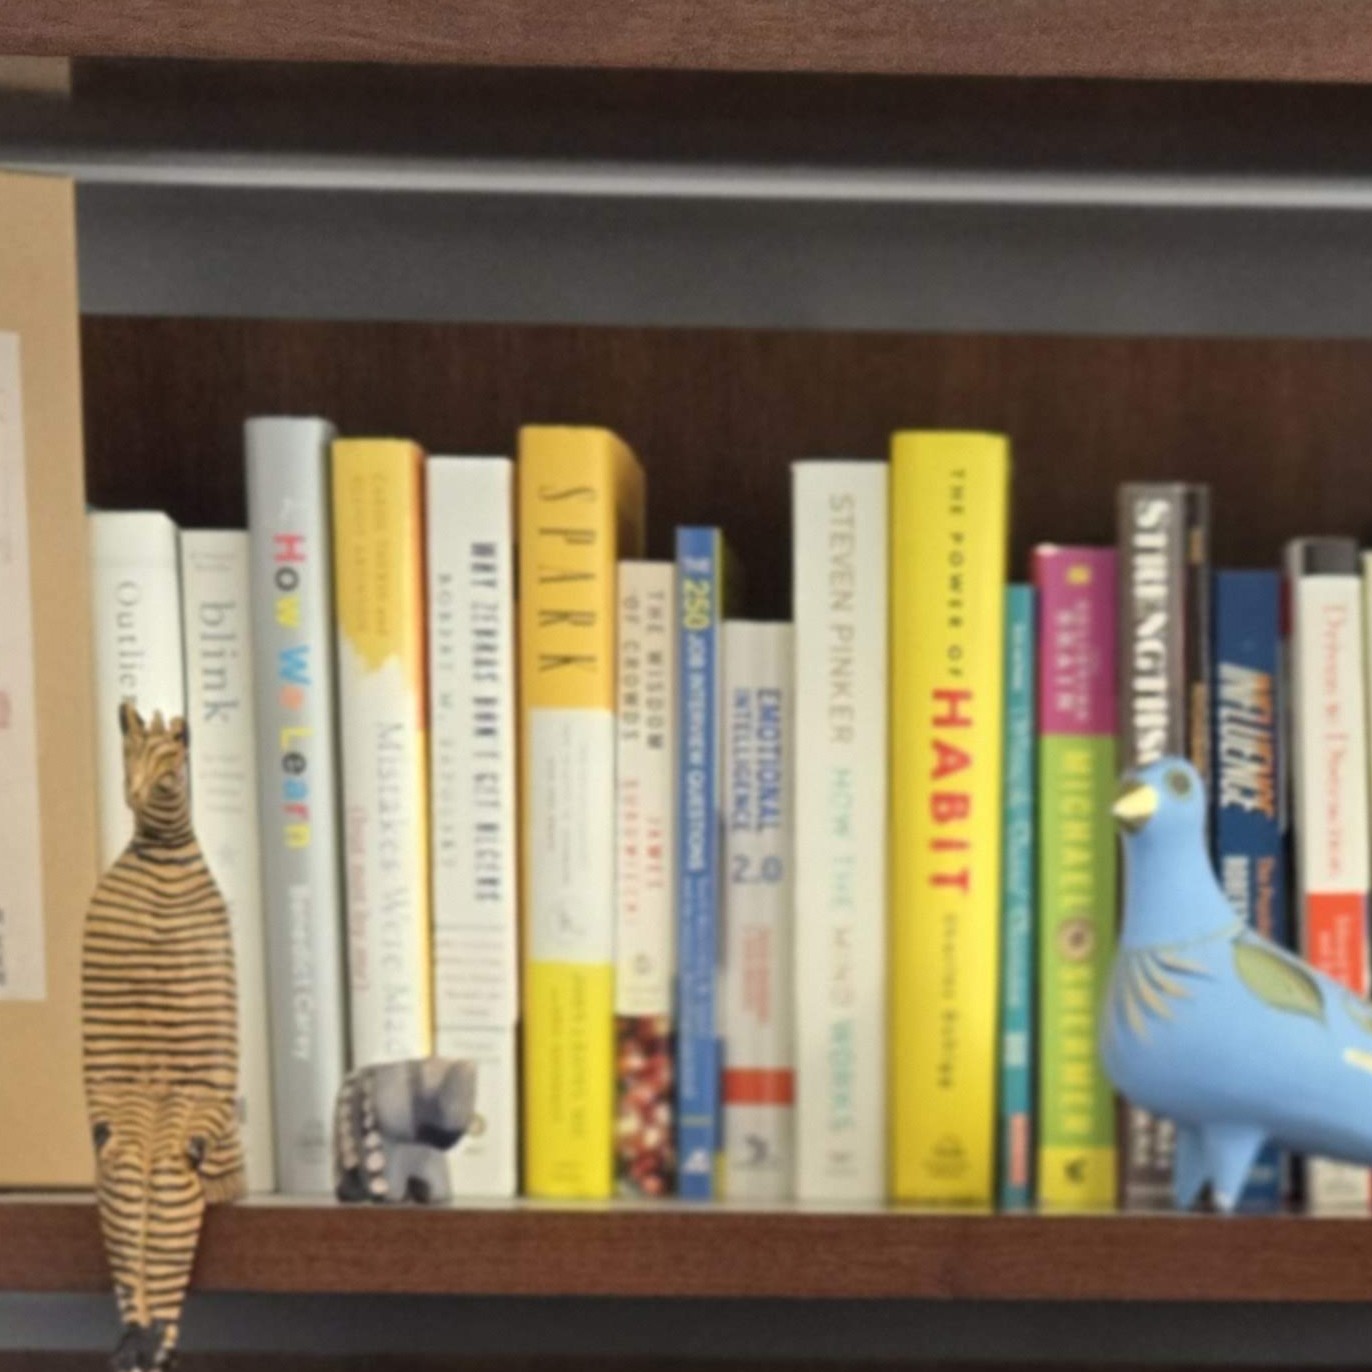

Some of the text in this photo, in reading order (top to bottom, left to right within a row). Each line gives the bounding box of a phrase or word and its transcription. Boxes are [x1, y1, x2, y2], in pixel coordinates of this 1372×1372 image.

[536, 486, 597, 673] SPARK
[683, 578, 710, 630] 250
[828, 492, 856, 612] STEVEN
[198, 601, 240, 723] blink
[273, 533, 314, 848] How We Learn
[471, 600, 499, 683] ZEBRAS
[622, 640, 641, 742] CROWDS
[646, 591, 666, 749] THE WISDOM
[828, 622, 857, 746] PINKER
[929, 467, 975, 896] THE POWER OF HABIT
[1132, 499, 1170, 765] STRENGTHS
[685, 672, 706, 766] INTERVIEW
[733, 687, 752, 831] INTELLIGENCE
[756, 687, 782, 831] EMOTIONAL
[1217, 661, 1275, 818] INFLUENCE
[376, 719, 406, 872] Mistakes
[685, 769, 707, 871] QUESTIONS
